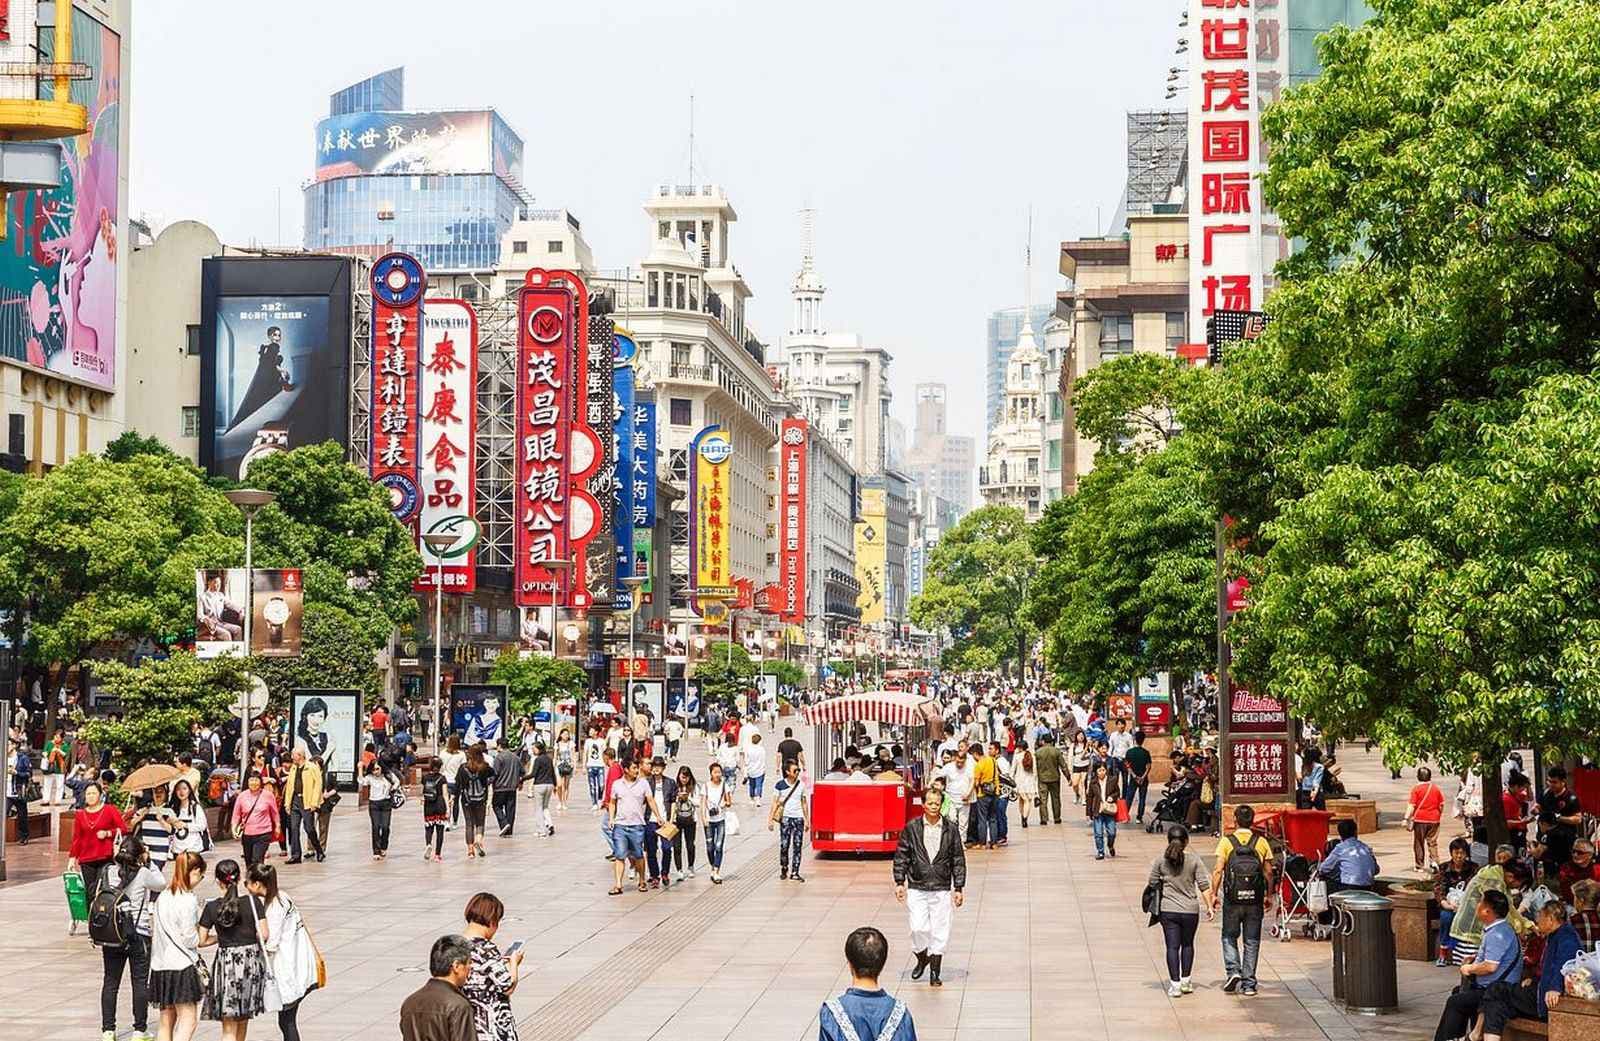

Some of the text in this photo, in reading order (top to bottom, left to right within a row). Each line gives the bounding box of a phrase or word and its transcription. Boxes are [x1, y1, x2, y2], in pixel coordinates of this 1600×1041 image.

[1201, 0, 1250, 316] 世茂国际广场
[424, 331, 466, 508] 泰康食品
[523, 351, 563, 565] 茂昌眼镜公司
[633, 405, 649, 525] 华美大药房
[1233, 743, 1282, 757] 纤体名牌
[1233, 757, 1282, 771] 香港直营
